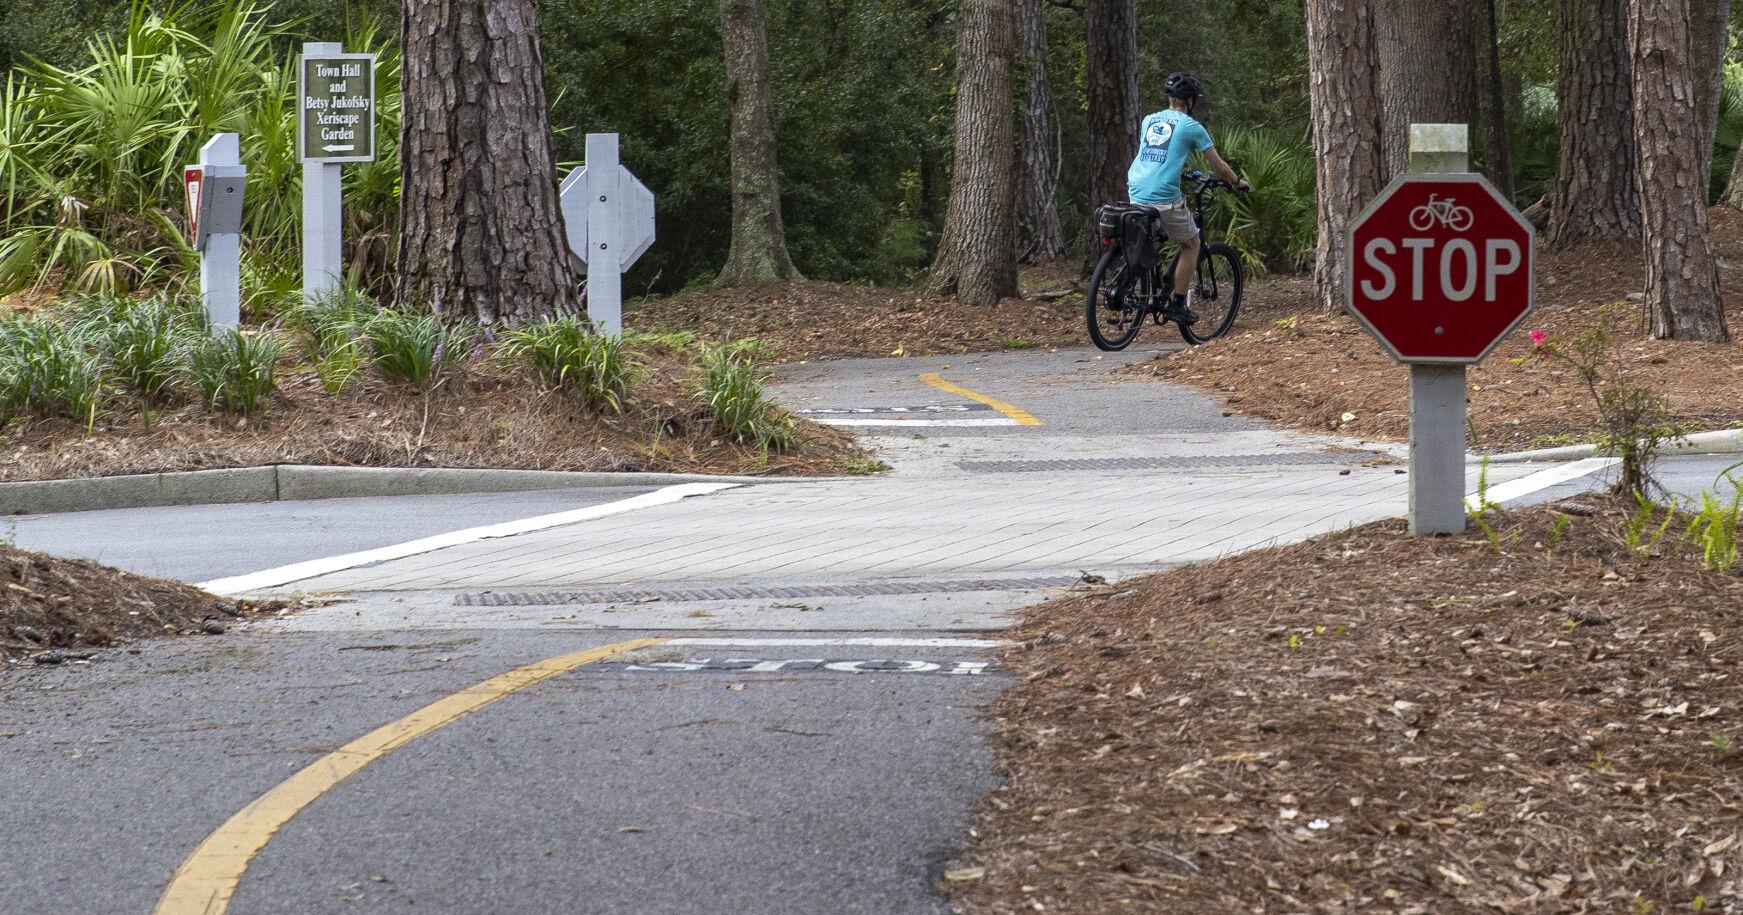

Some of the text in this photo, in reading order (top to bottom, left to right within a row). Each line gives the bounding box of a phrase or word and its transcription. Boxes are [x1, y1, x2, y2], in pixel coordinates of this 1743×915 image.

[316, 64, 361, 77] Town Hall
[329, 80, 347, 93] and
[306, 95, 370, 111] Betsy Jukofsky
[316, 112, 360, 127] Xeriscape
[321, 127, 355, 140] Garden
[1360, 237, 1522, 302] STOP
